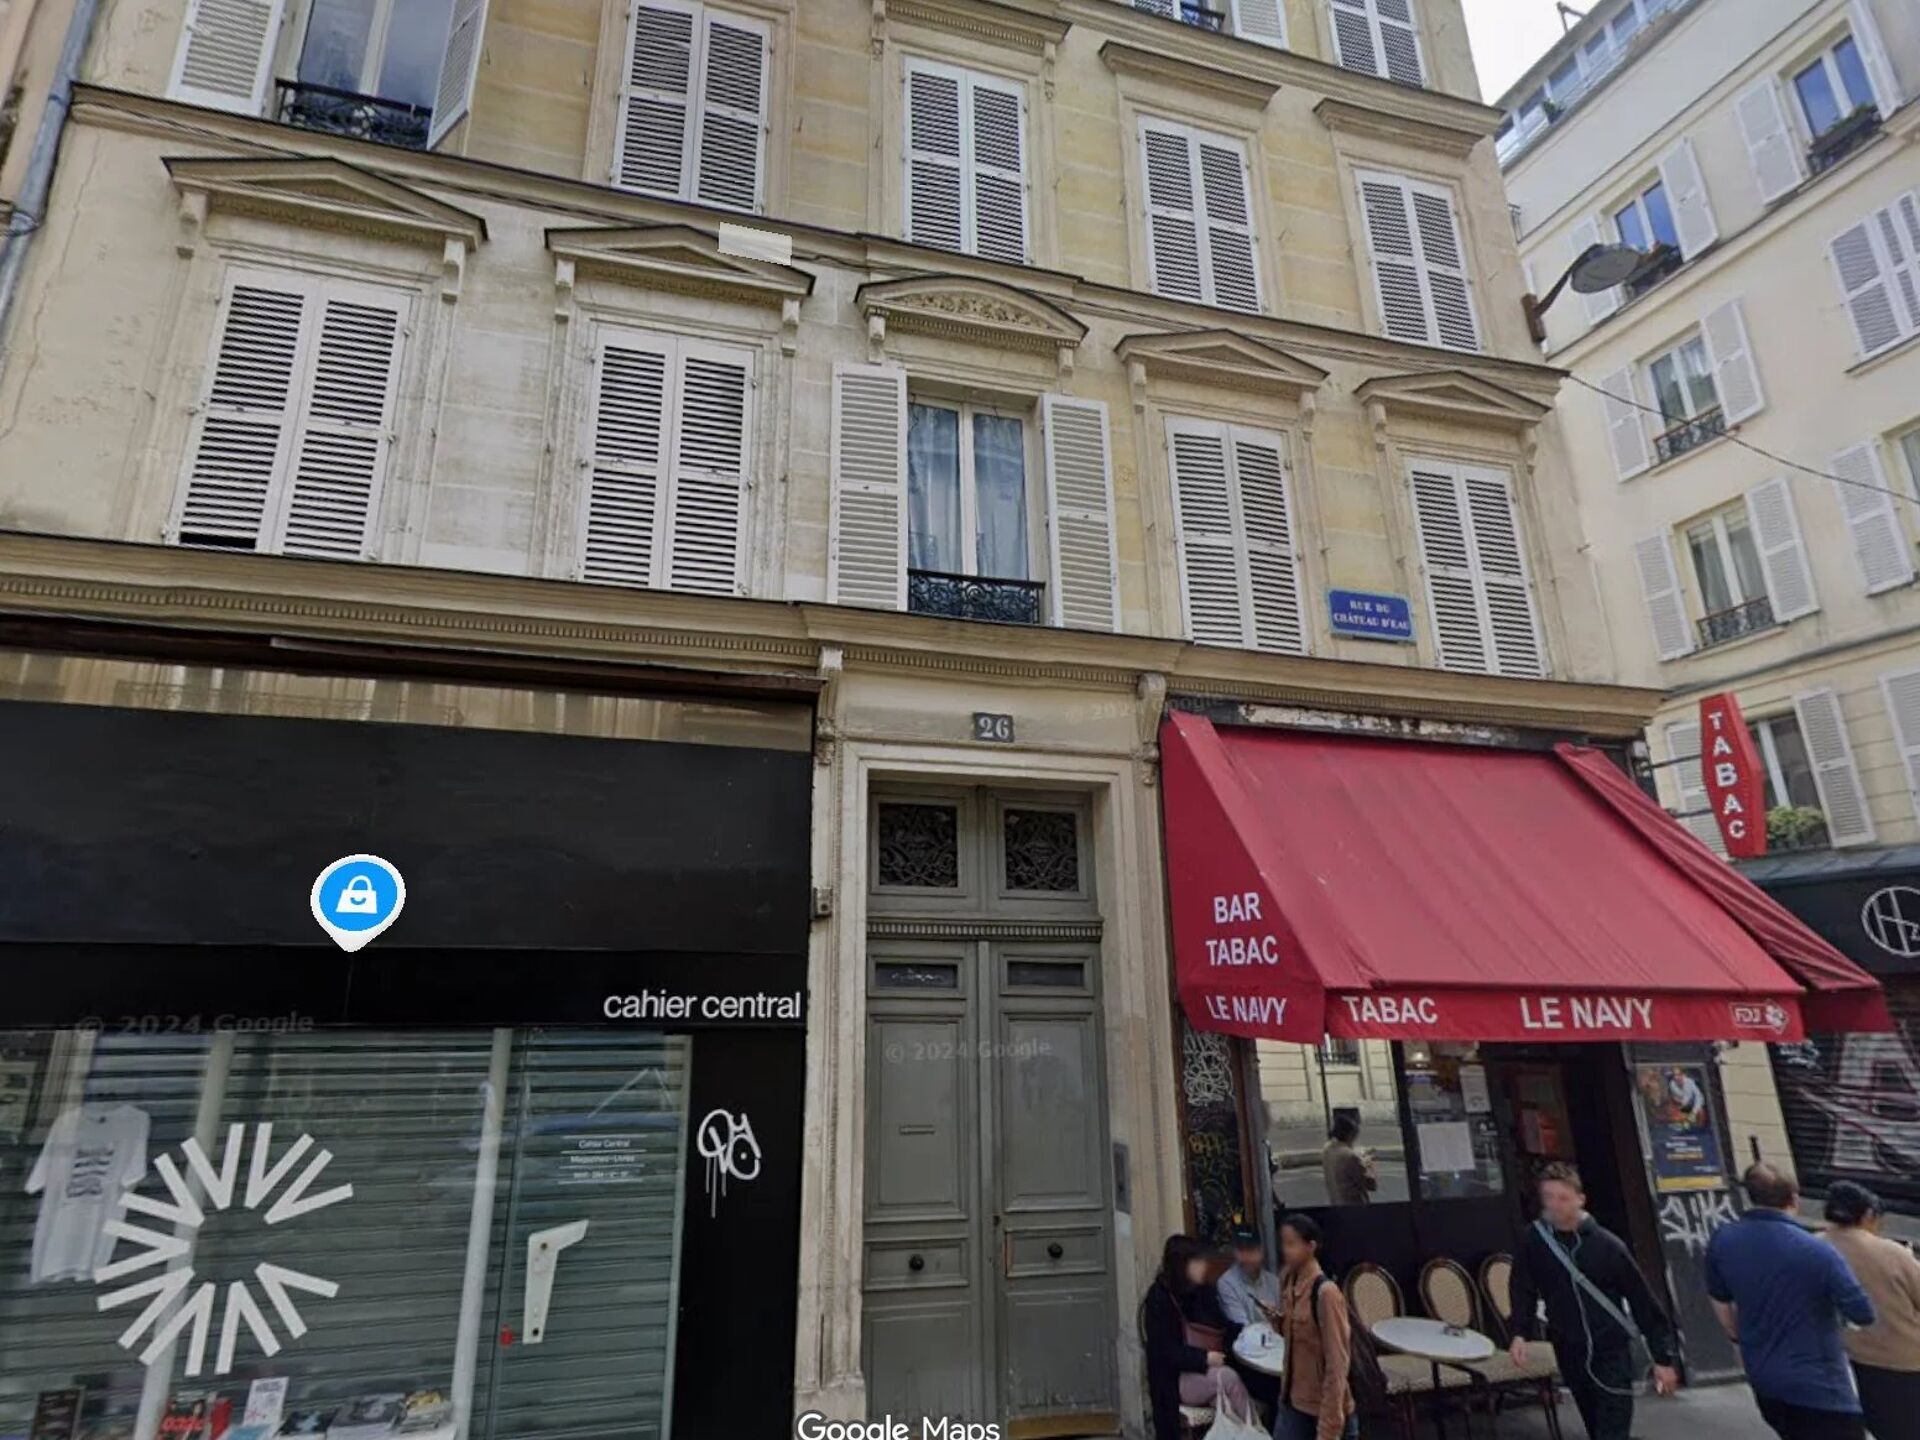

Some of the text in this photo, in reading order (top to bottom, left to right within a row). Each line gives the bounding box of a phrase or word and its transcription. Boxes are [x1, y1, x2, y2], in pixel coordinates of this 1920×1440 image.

[1349, 600, 1372, 612] RUE
[979, 716, 1009, 740] 26
[1708, 711, 1746, 838] TABAC
[1213, 892, 1262, 923] BAR
[1205, 935, 1278, 966] TABAC
[603, 989, 801, 1018] cahier central
[1205, 995, 1287, 1026] LE NAVY
[1341, 996, 1438, 1023] TABAC
[1519, 997, 1654, 1030] LE NAVY
